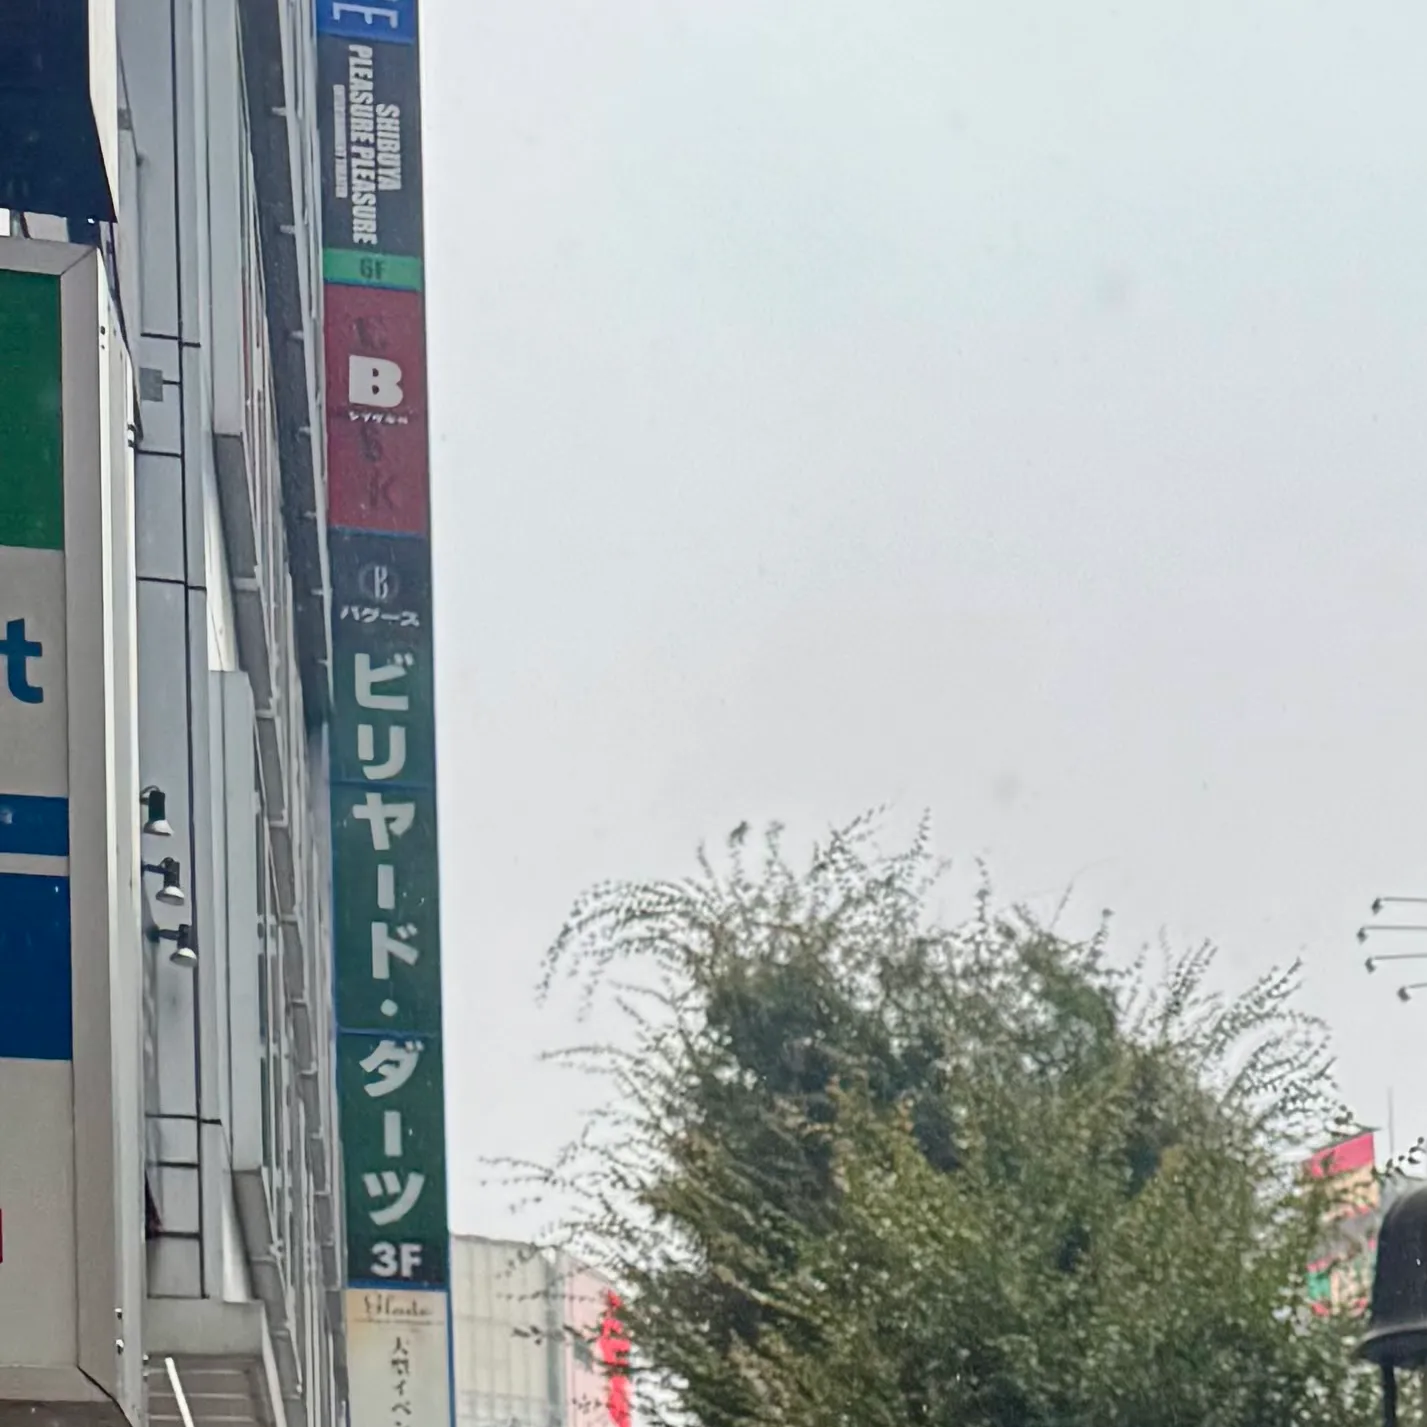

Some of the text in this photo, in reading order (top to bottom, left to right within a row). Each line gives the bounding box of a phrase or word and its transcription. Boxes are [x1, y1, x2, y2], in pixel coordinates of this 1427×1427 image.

[349, 44, 378, 246] PLEASURE PLEASURE
[376, 103, 402, 190] SHIBUYA
[354, 650, 426, 1227] ビリヤード・ダーツ
[370, 1242, 423, 1278] 3F
